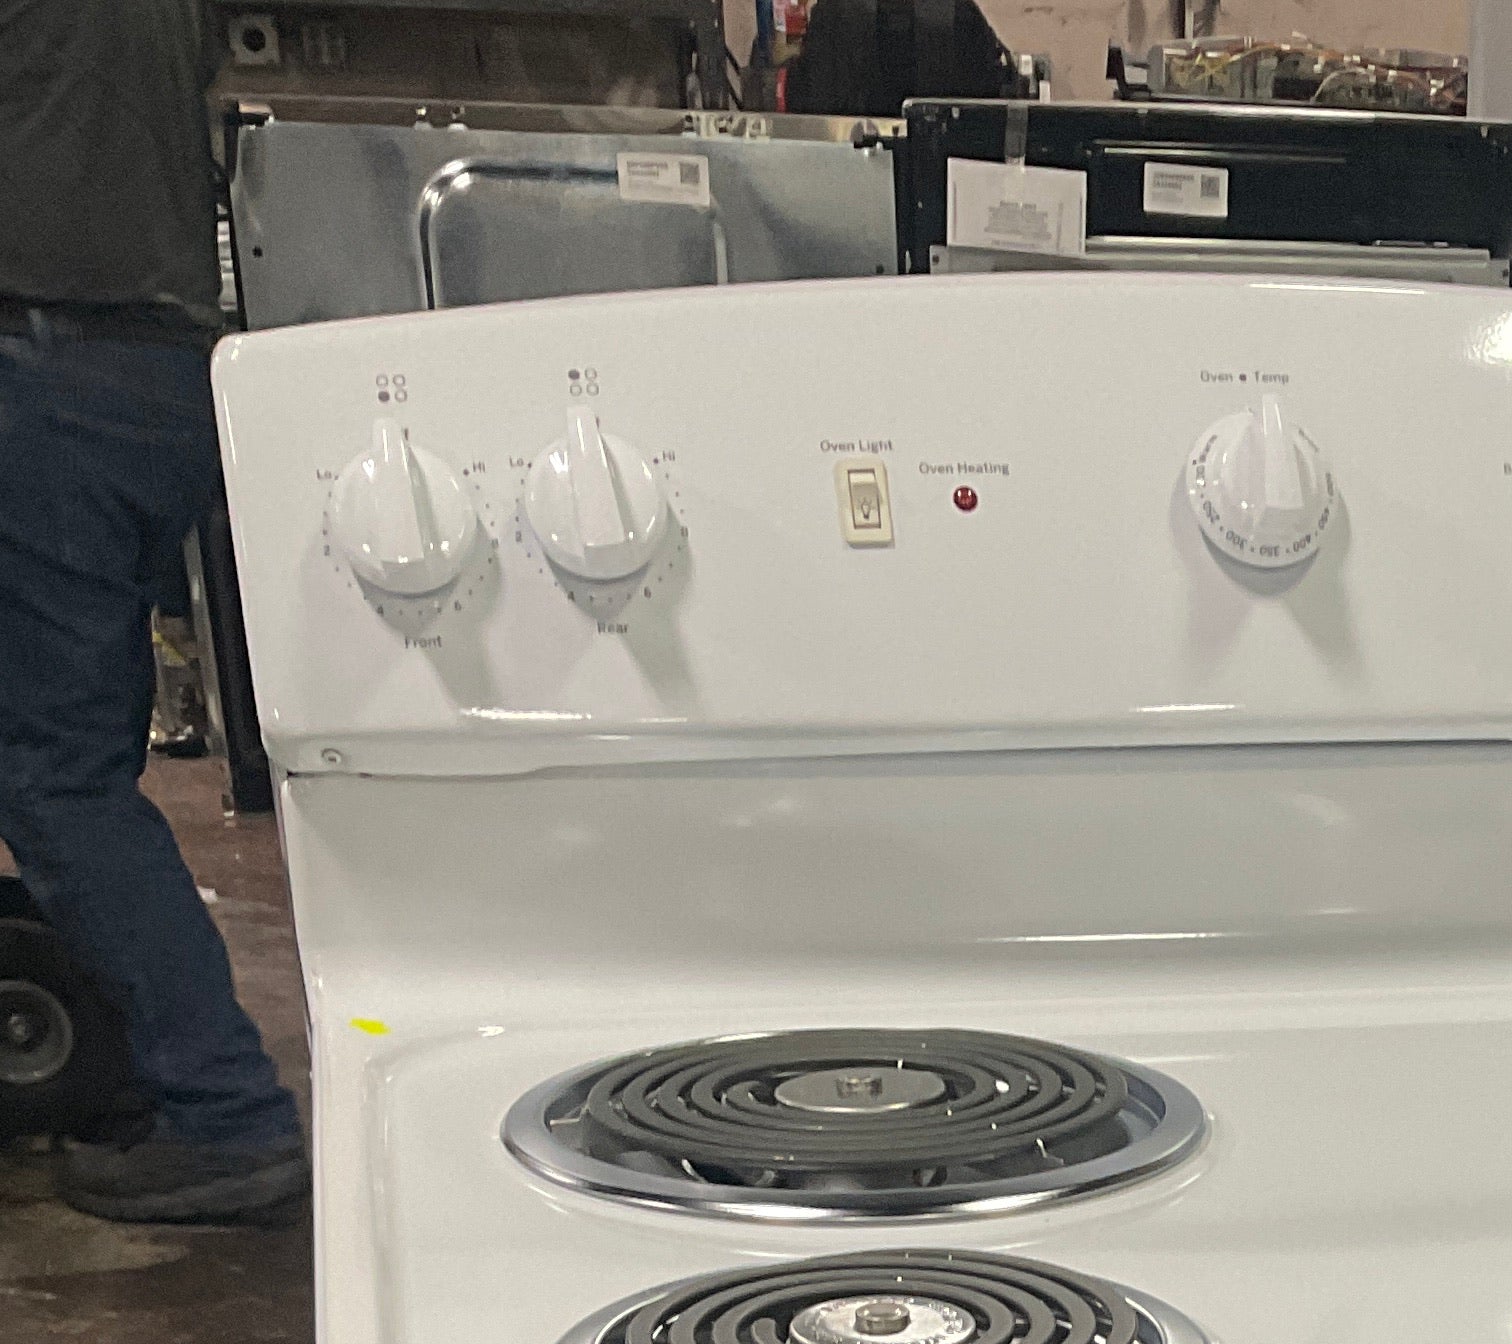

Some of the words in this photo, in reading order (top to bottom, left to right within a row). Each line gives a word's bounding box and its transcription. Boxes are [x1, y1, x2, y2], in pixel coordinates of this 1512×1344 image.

[1200, 371, 1233, 383] Oven
[1255, 371, 1289, 384] Temp
[820, 439, 855, 452] Oven
[859, 439, 893, 454] Light
[919, 462, 954, 475] Oven
[957, 461, 1010, 476] Heating
[404, 635, 443, 649] Front
